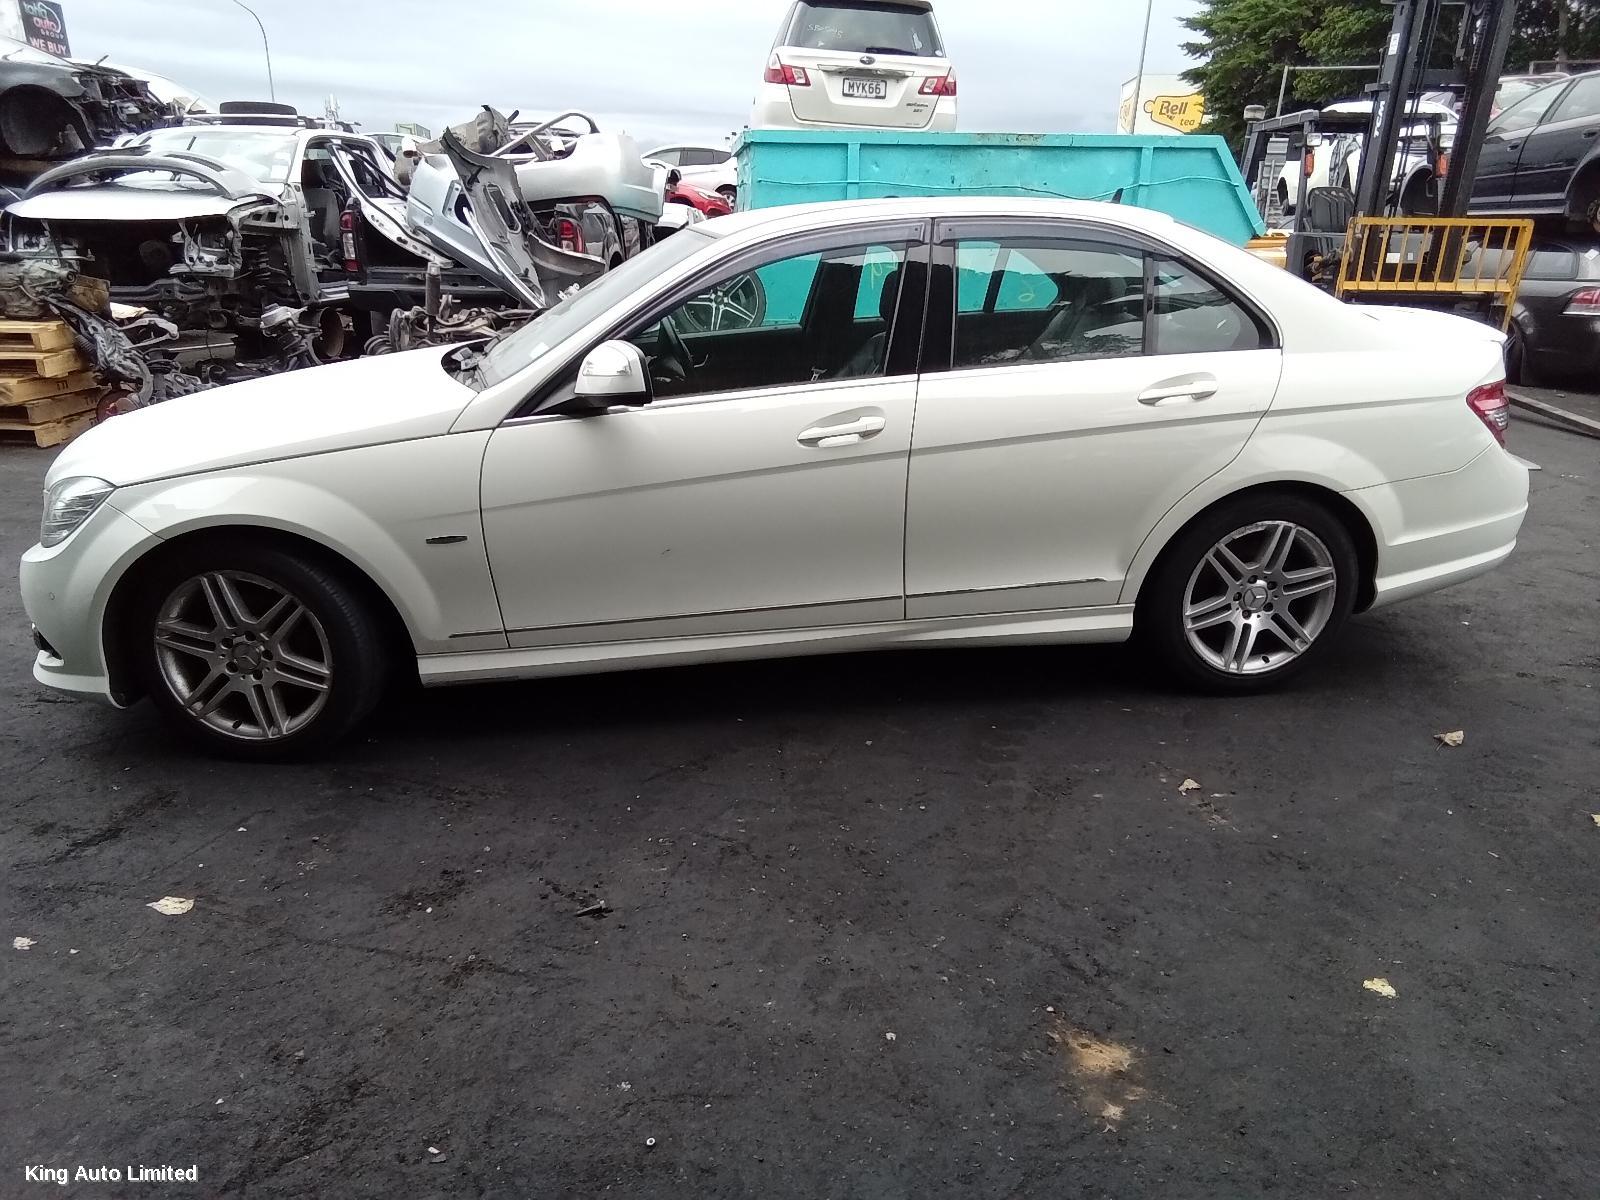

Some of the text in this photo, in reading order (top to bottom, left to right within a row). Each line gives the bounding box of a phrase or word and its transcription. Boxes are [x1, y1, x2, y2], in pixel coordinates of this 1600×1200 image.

[33, 16, 57, 31] auto
[40, 28, 64, 39] GROUP
[29, 36, 66, 55] WE BUY
[848, 81, 881, 95] MYK66
[1158, 100, 1188, 116] Bell
[1180, 118, 1195, 126] tea
